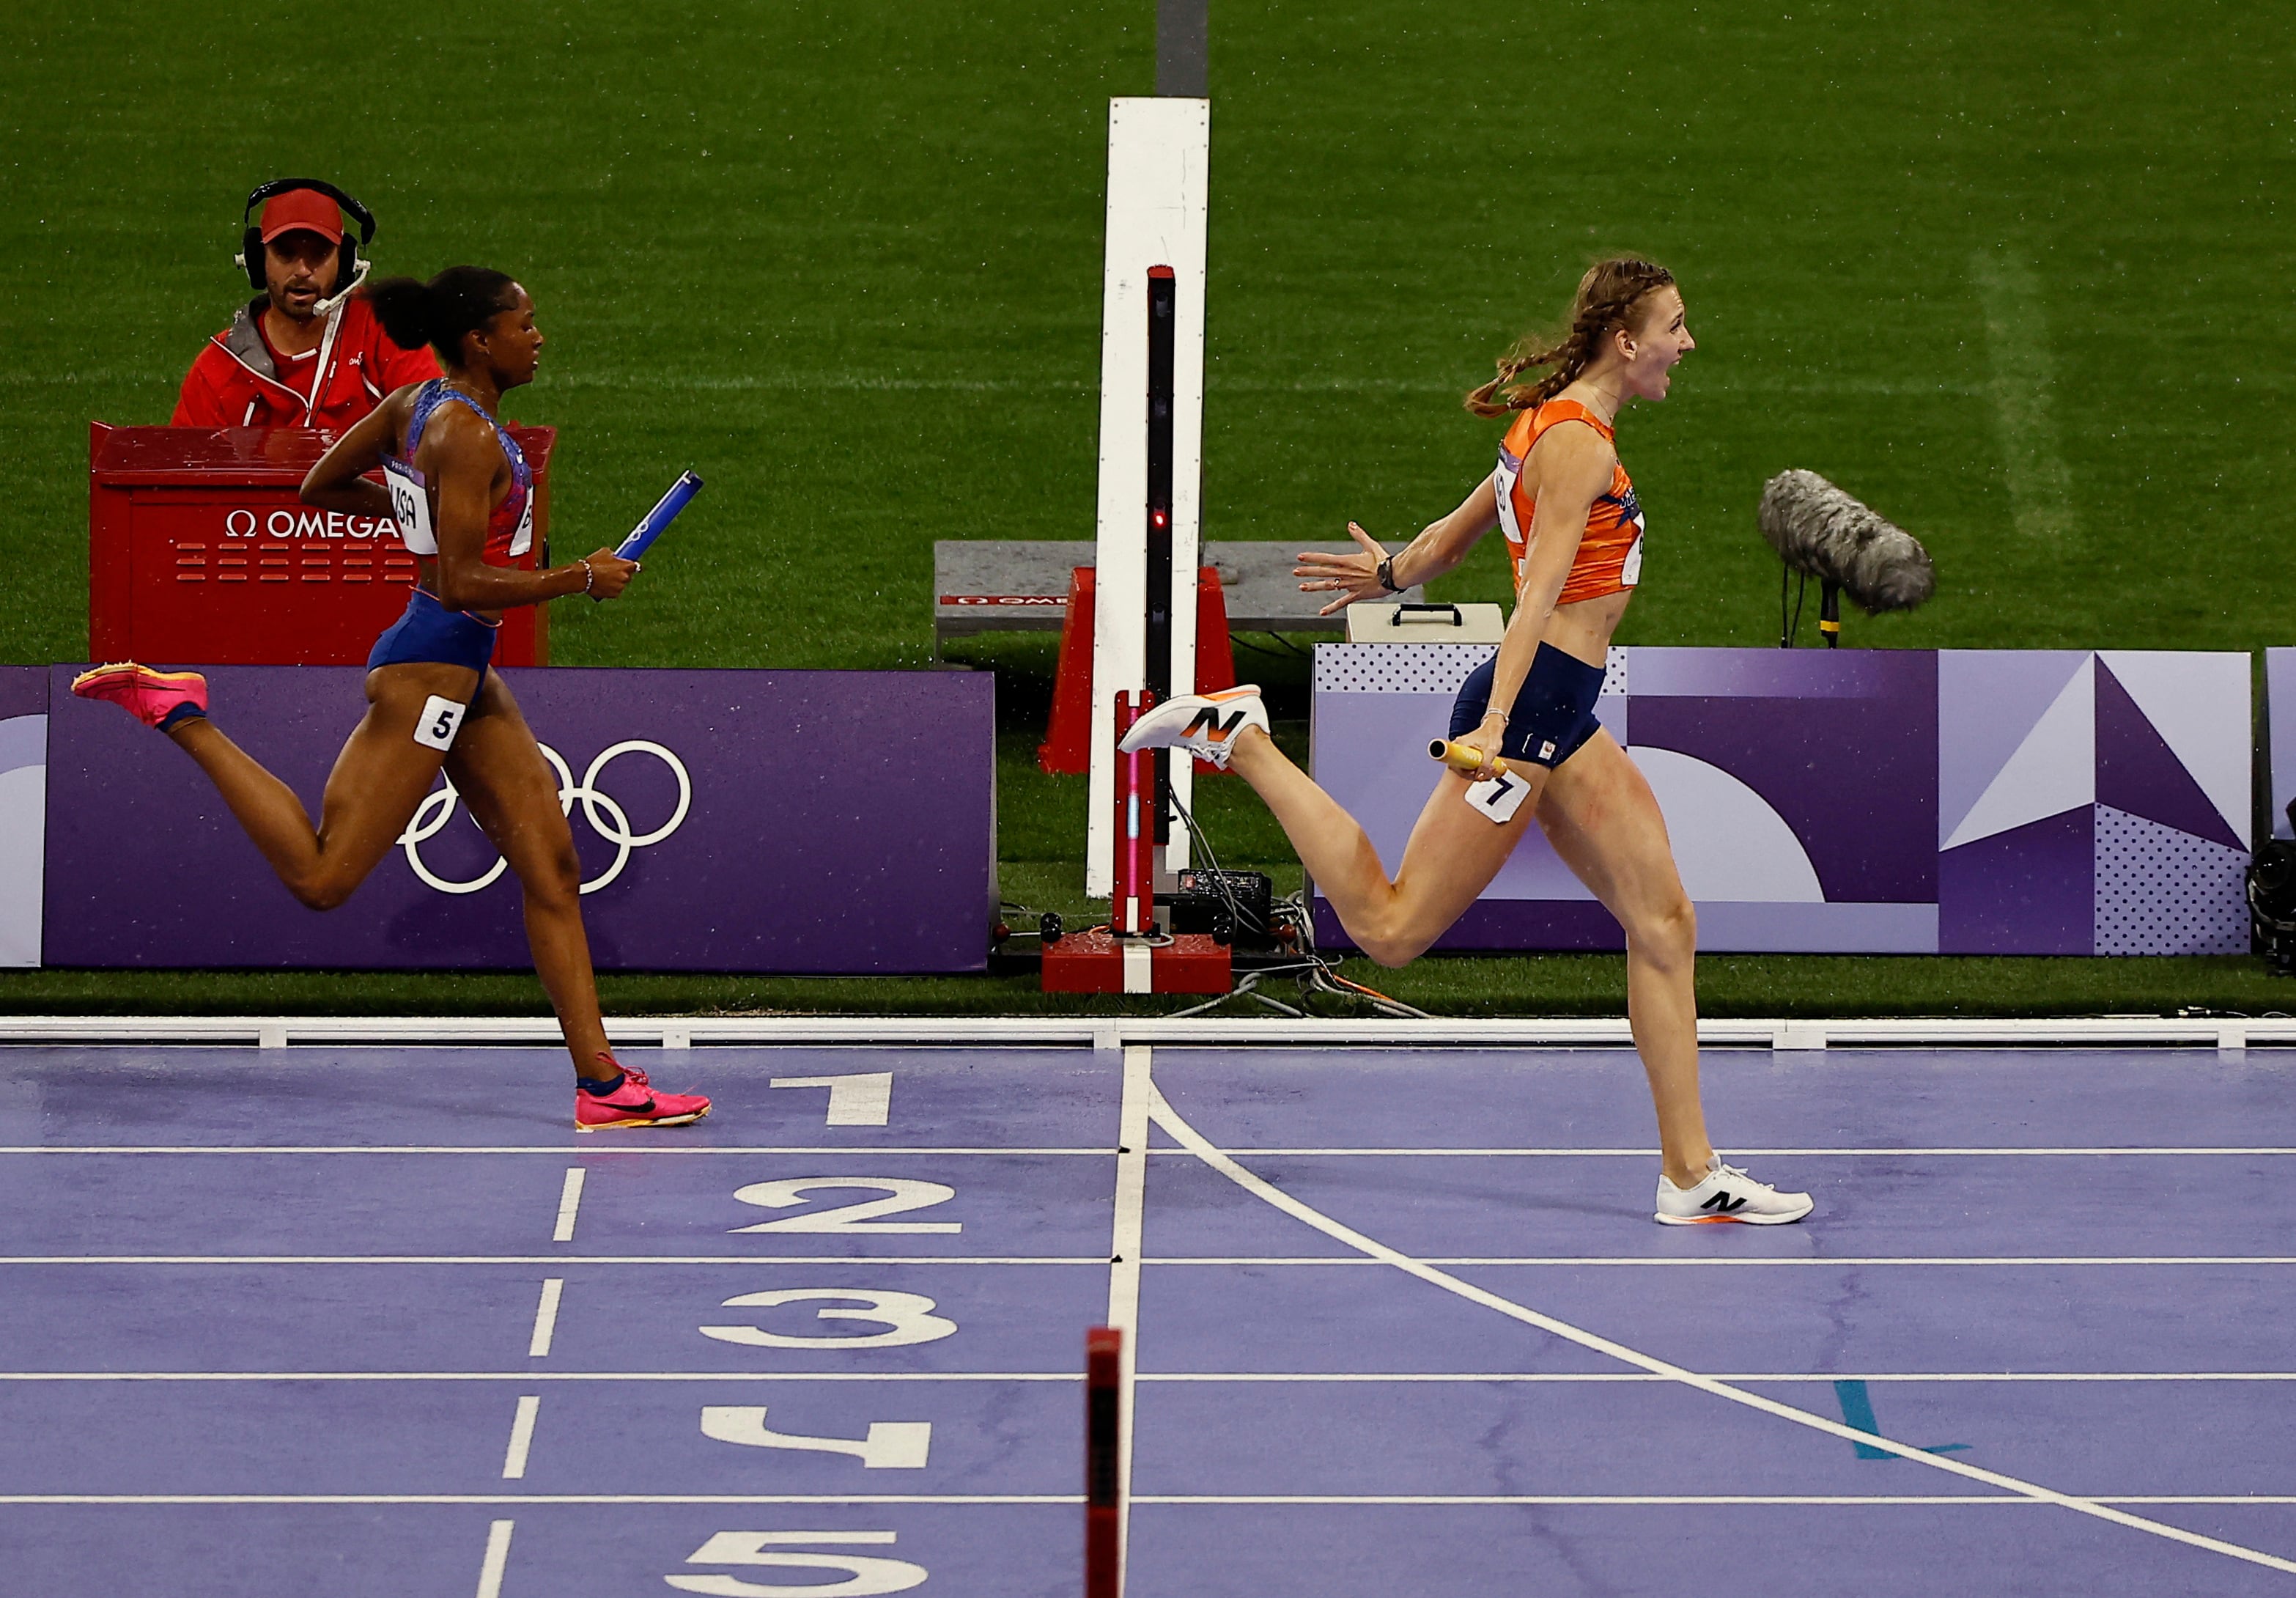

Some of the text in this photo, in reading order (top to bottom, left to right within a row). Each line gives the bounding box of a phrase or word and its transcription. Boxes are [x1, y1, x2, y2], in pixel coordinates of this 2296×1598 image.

[267, 511, 399, 538] OMEGA
[432, 710, 454, 740] 5
[1179, 707, 1247, 743] N
[1485, 776, 1515, 806] 7
[769, 1071, 893, 1126] 1
[725, 1177, 962, 1234] 2
[1699, 1190, 1748, 1212] N
[698, 1288, 959, 1349] 3
[700, 1405, 932, 1469] 4
[663, 1531, 929, 1598] 5
